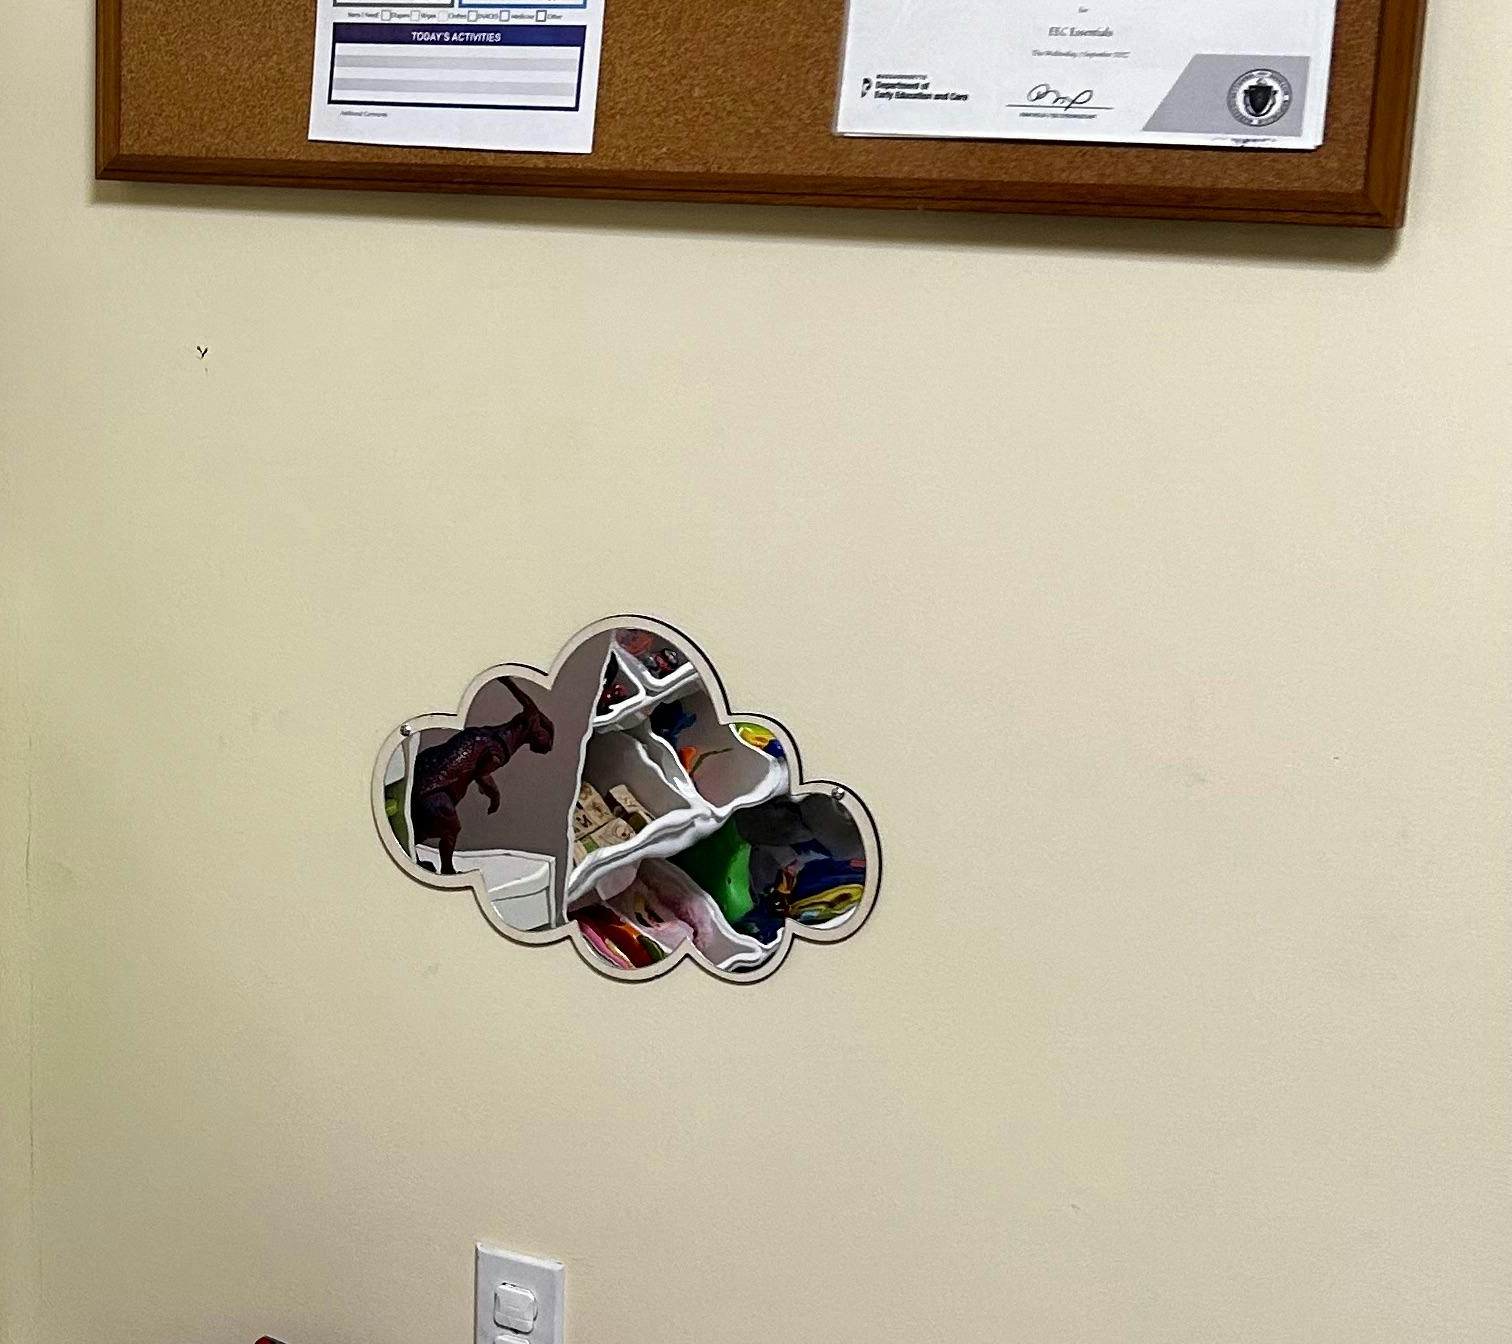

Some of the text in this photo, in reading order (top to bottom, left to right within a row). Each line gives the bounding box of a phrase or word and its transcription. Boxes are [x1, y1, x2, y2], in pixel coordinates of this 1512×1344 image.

[1070, 27, 1113, 36] Essentials
[412, 32, 501, 42] TODAY'S ACTIVITIES
[876, 82, 929, 90] Department of
[874, 91, 968, 101] Early Education and Care
